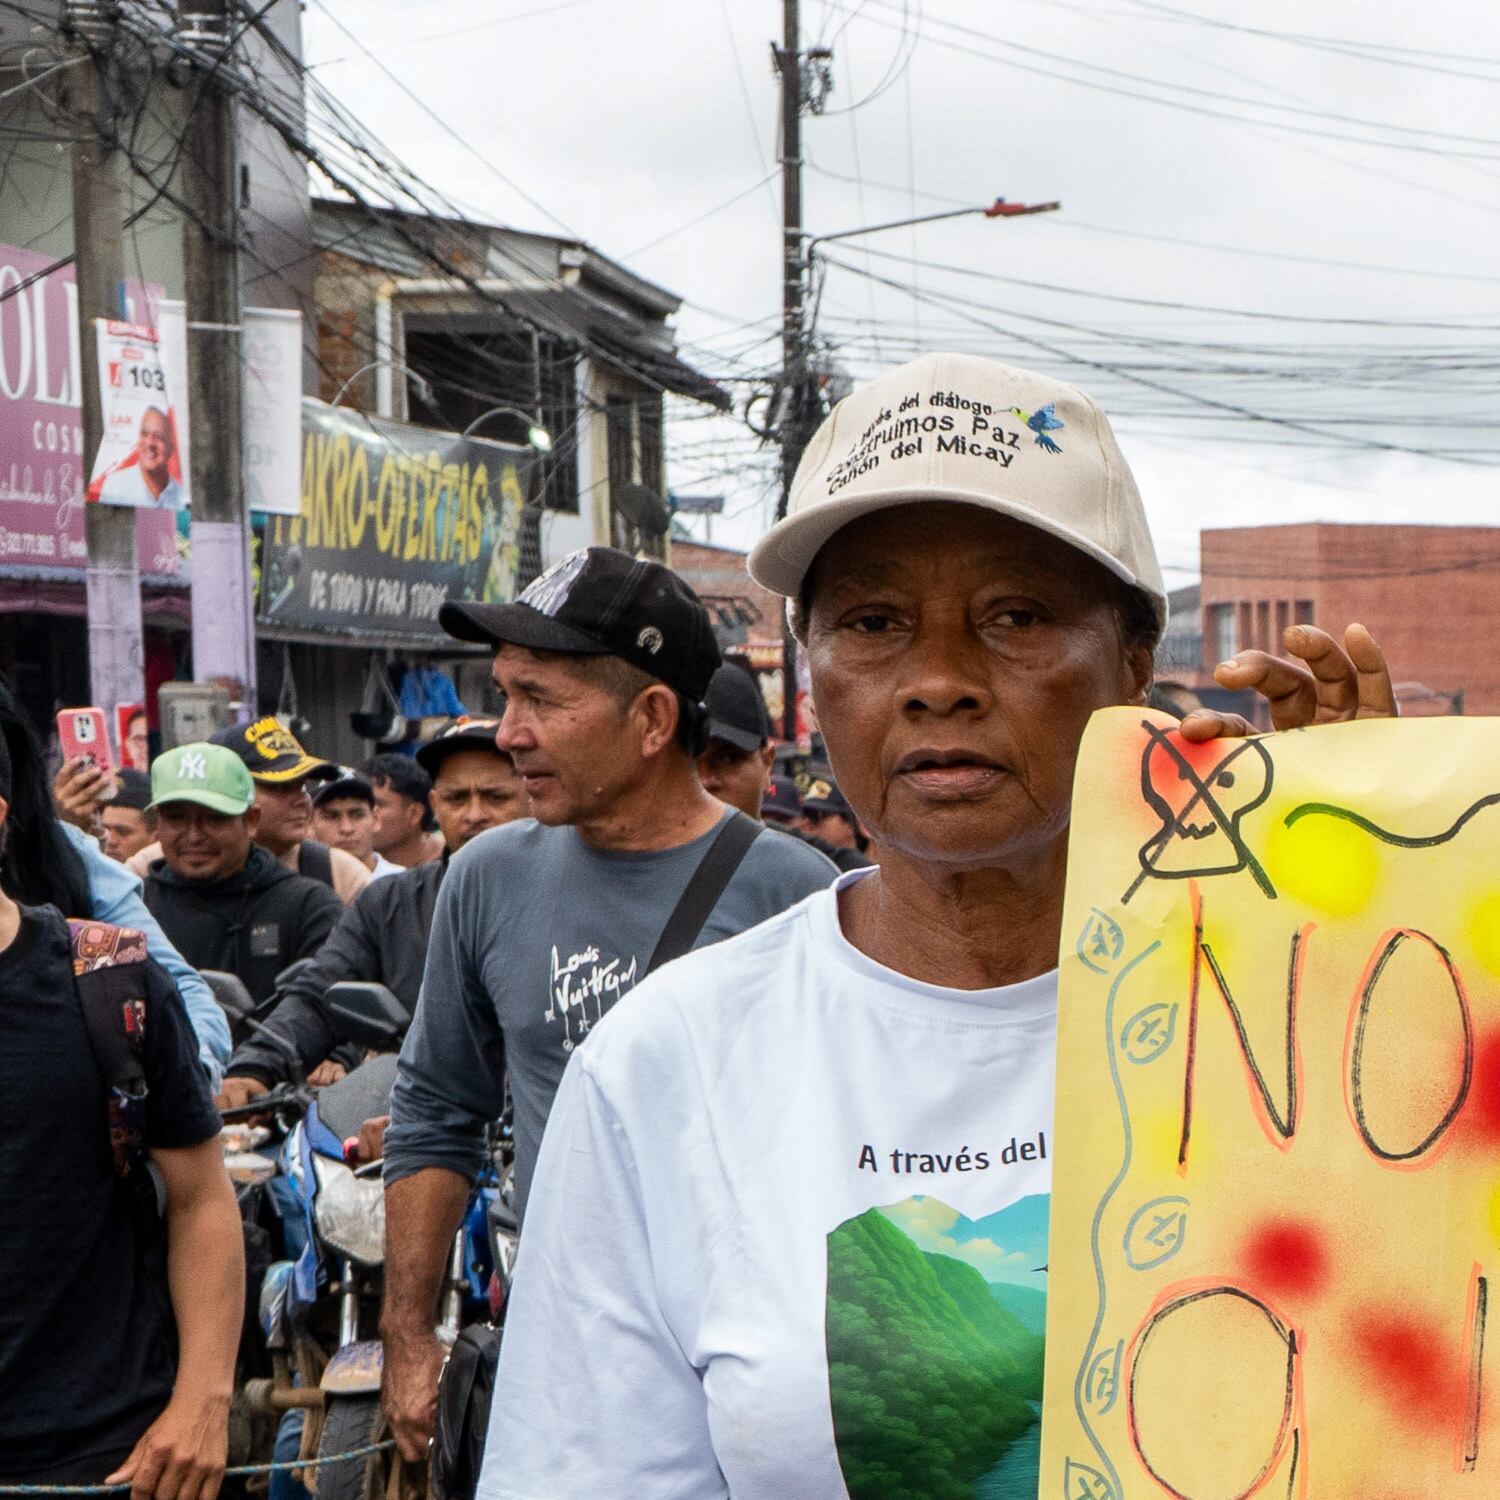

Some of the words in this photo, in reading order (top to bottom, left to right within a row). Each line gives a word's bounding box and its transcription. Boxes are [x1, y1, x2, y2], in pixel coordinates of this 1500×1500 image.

[130, 365, 165, 392] 103
[898, 393, 920, 413] del
[930, 391, 992, 416] diálogo
[972, 416, 1020, 450] Paz
[891, 437, 922, 460] del
[936, 434, 1014, 468] Micay
[1175, 878, 1474, 1178] NO
[858, 1144, 878, 1173] A
[889, 1145, 990, 1174] través
[1001, 1132, 1047, 1165] del
